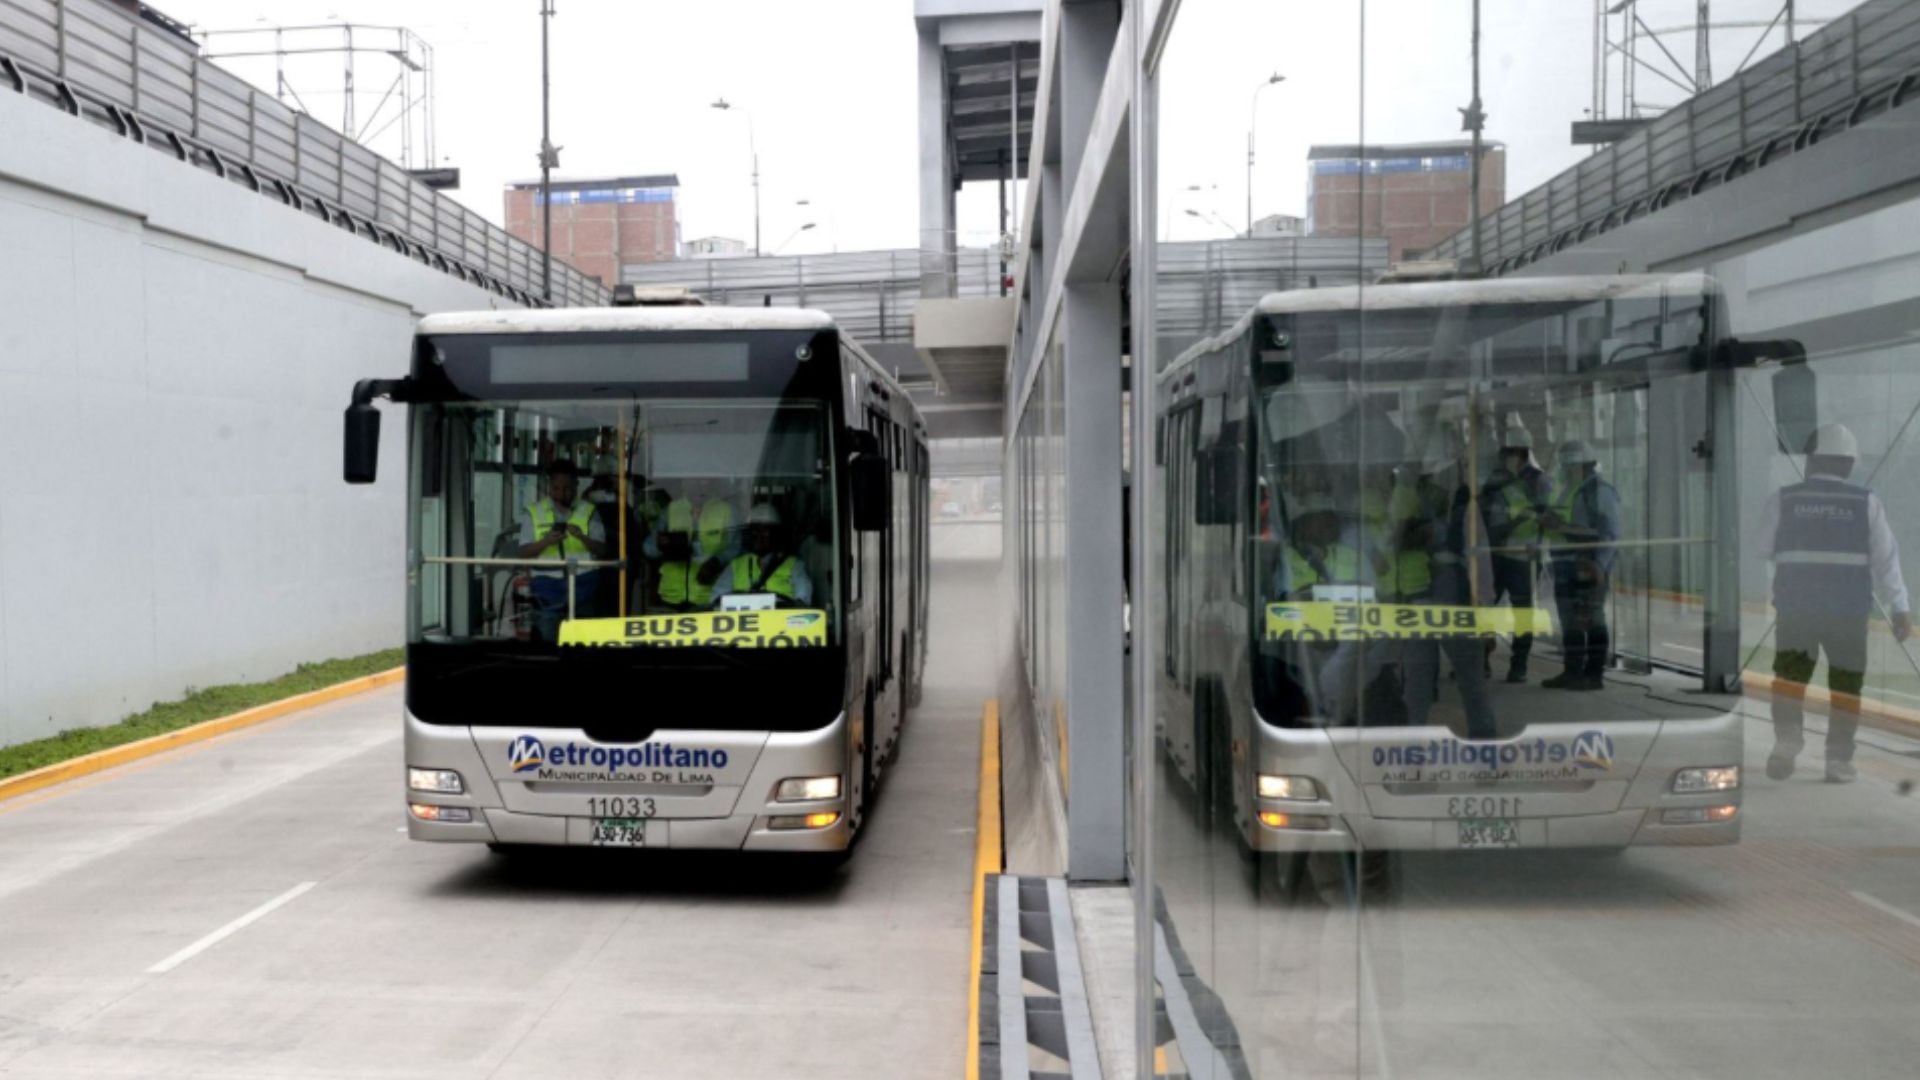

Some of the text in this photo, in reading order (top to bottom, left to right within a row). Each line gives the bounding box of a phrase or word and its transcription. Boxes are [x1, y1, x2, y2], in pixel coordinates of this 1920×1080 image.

[624, 613, 760, 637] BUS DE
[561, 631, 822, 647] UCCIÓN
[508, 735, 728, 773] Metropolitano
[588, 797, 657, 817] 11033
